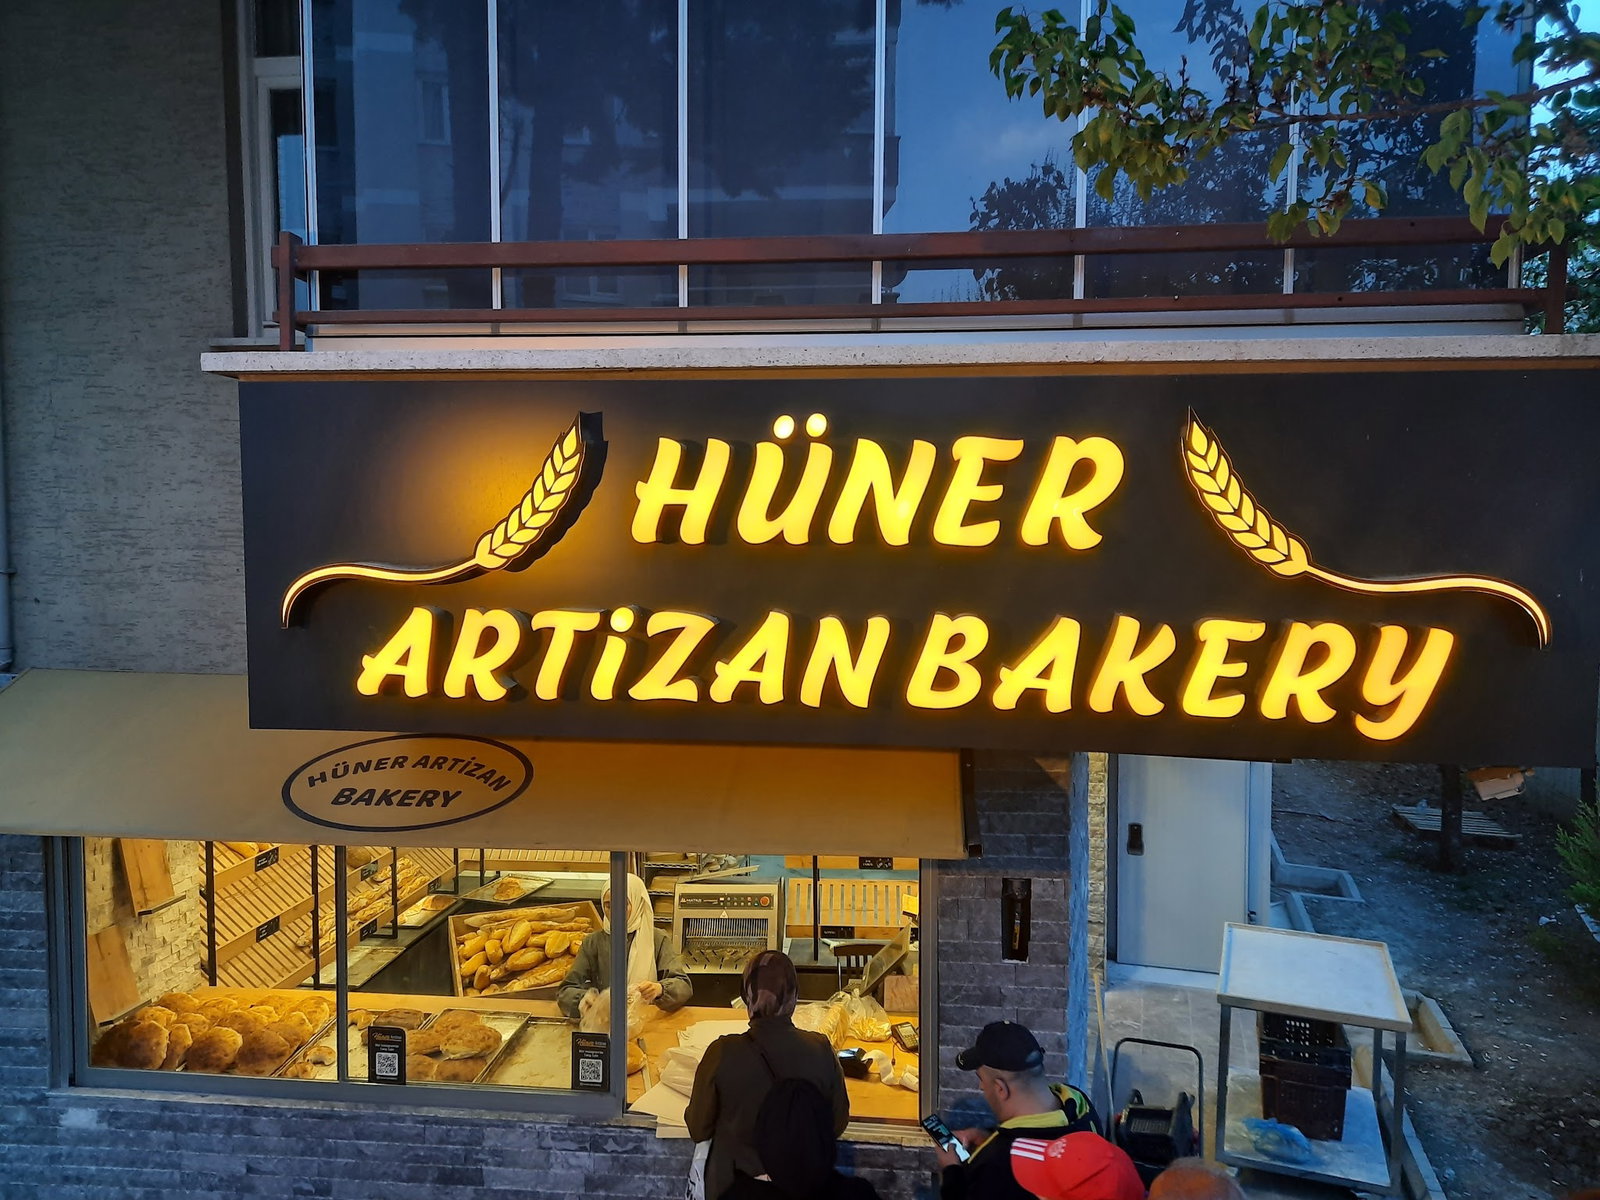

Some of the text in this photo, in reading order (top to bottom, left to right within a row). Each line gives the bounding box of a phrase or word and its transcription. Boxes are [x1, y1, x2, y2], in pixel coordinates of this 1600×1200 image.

[630, 412, 1125, 551] HÜNER
[905, 613, 1456, 742] BAKERY
[307, 755, 409, 788] HÜNER
[330, 787, 463, 808] BAKERY
